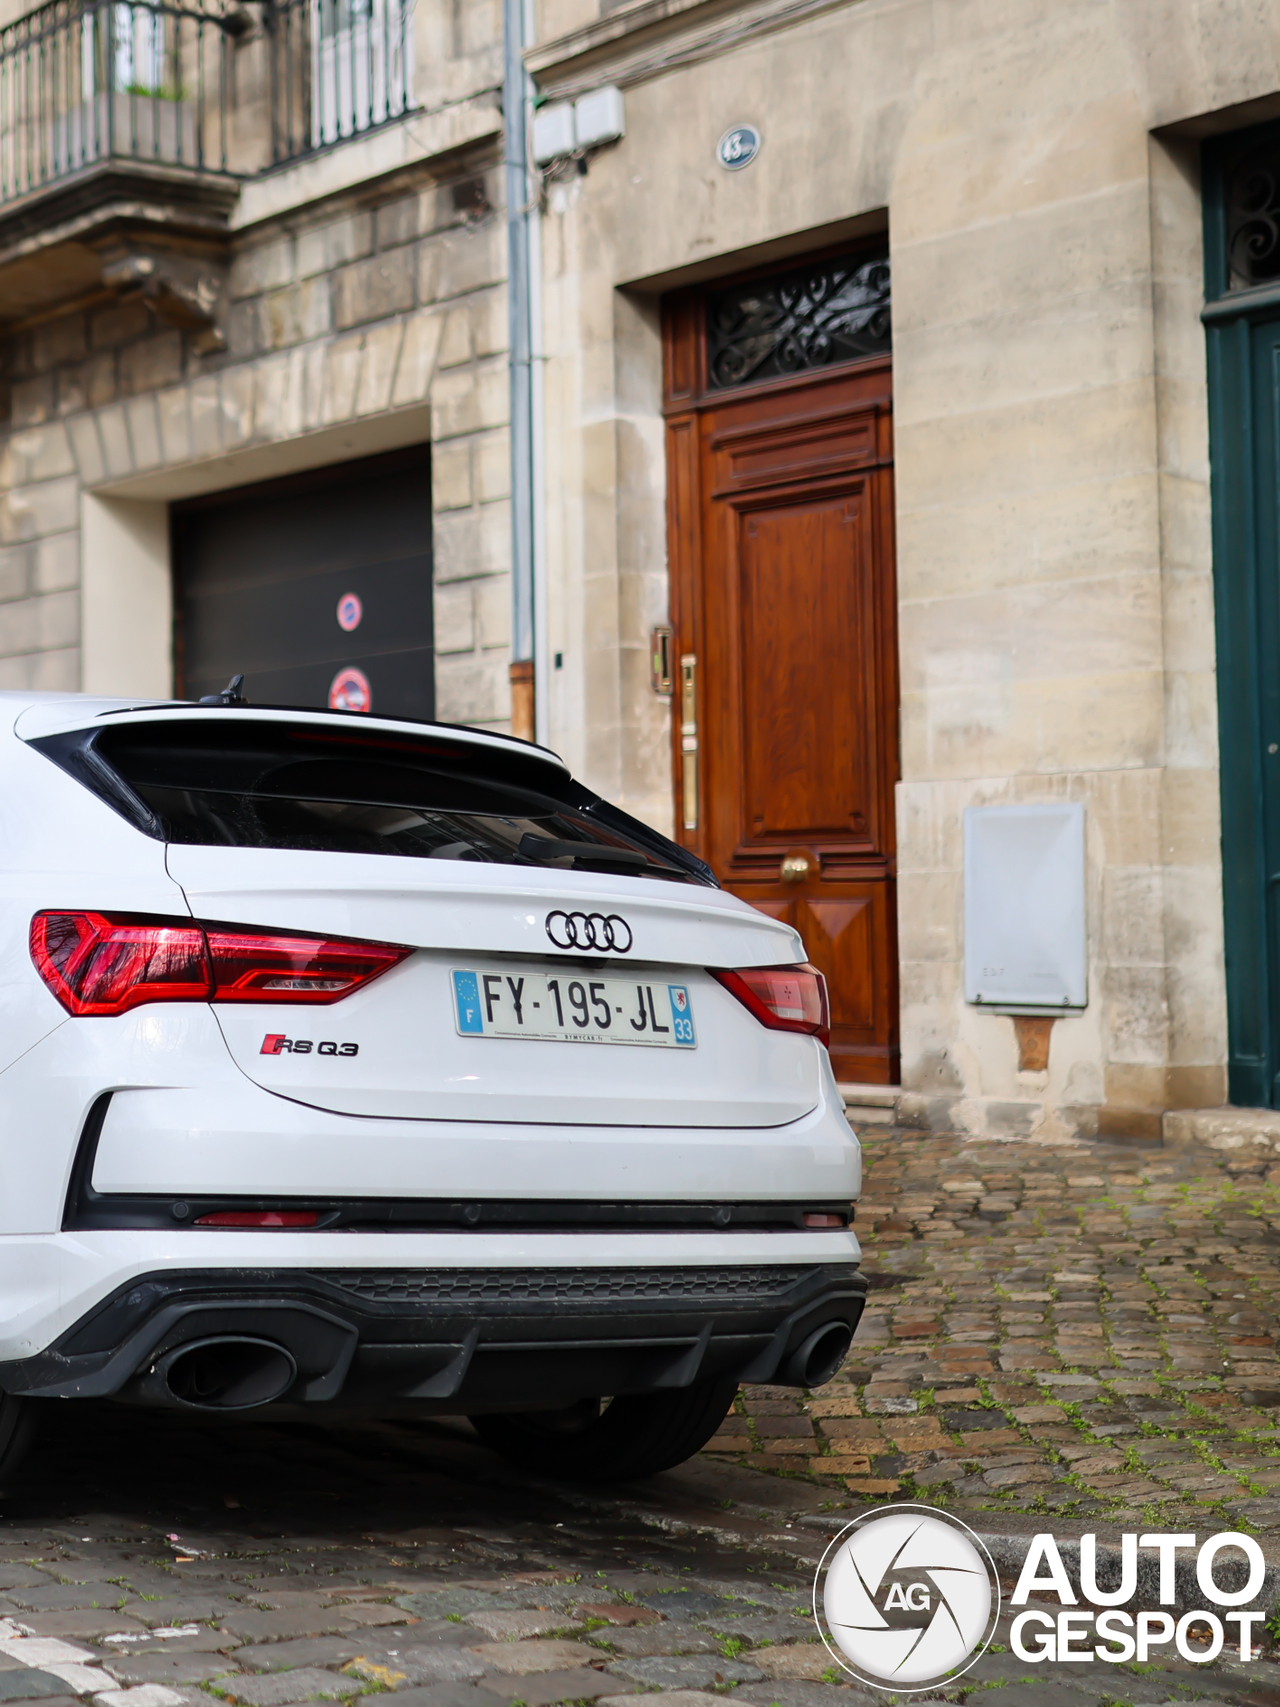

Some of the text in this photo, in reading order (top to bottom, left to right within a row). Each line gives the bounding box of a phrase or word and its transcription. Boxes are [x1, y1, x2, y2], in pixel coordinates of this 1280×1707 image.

[482, 975, 669, 1033] FY-195-JL
[465, 1009, 474, 1024] F
[675, 1018, 694, 1041] 33
[273, 1039, 359, 1057] RS Q3
